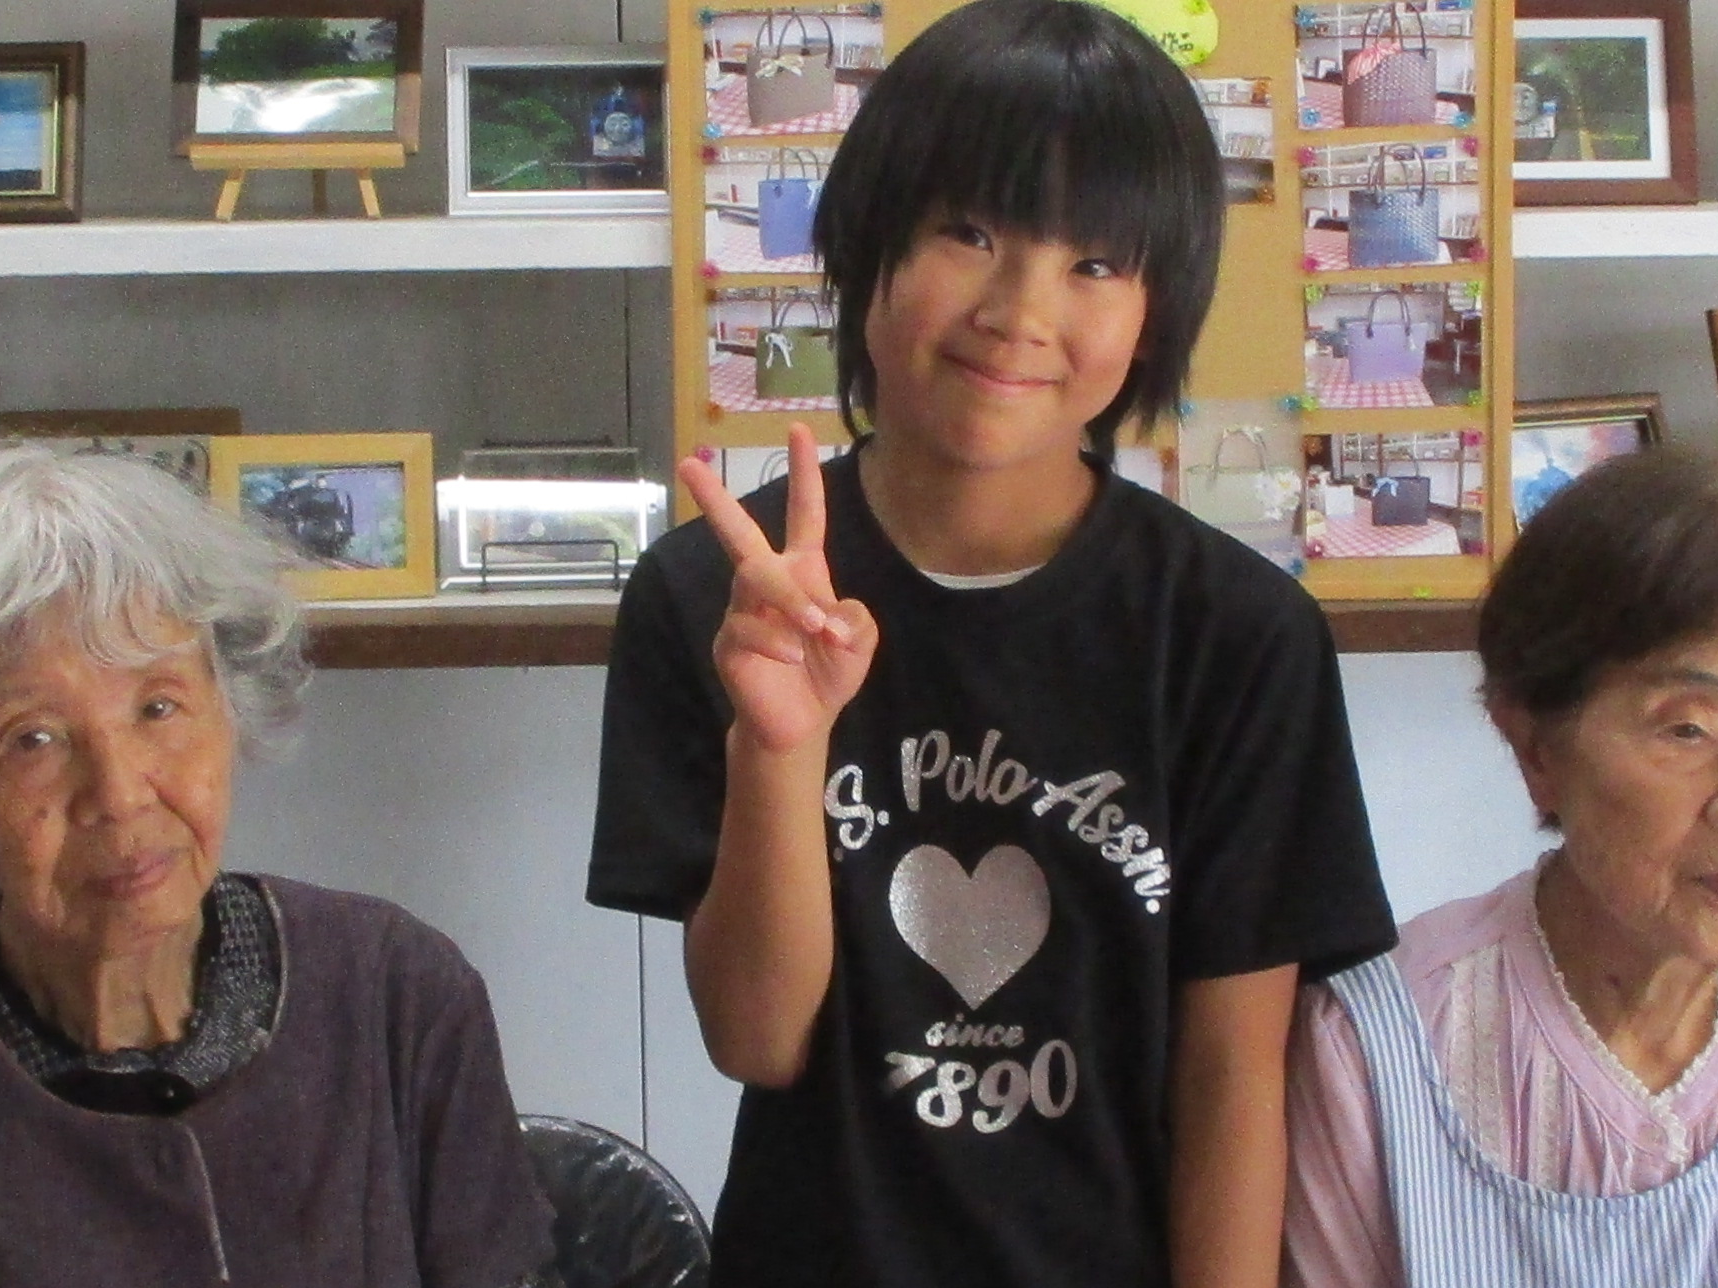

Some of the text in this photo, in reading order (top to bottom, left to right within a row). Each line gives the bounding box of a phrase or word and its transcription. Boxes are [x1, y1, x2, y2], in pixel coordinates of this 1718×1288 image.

[900, 728, 1038, 813] Polo
[1030, 769, 1172, 916] Assn.
[925, 1012, 1026, 1049] since
